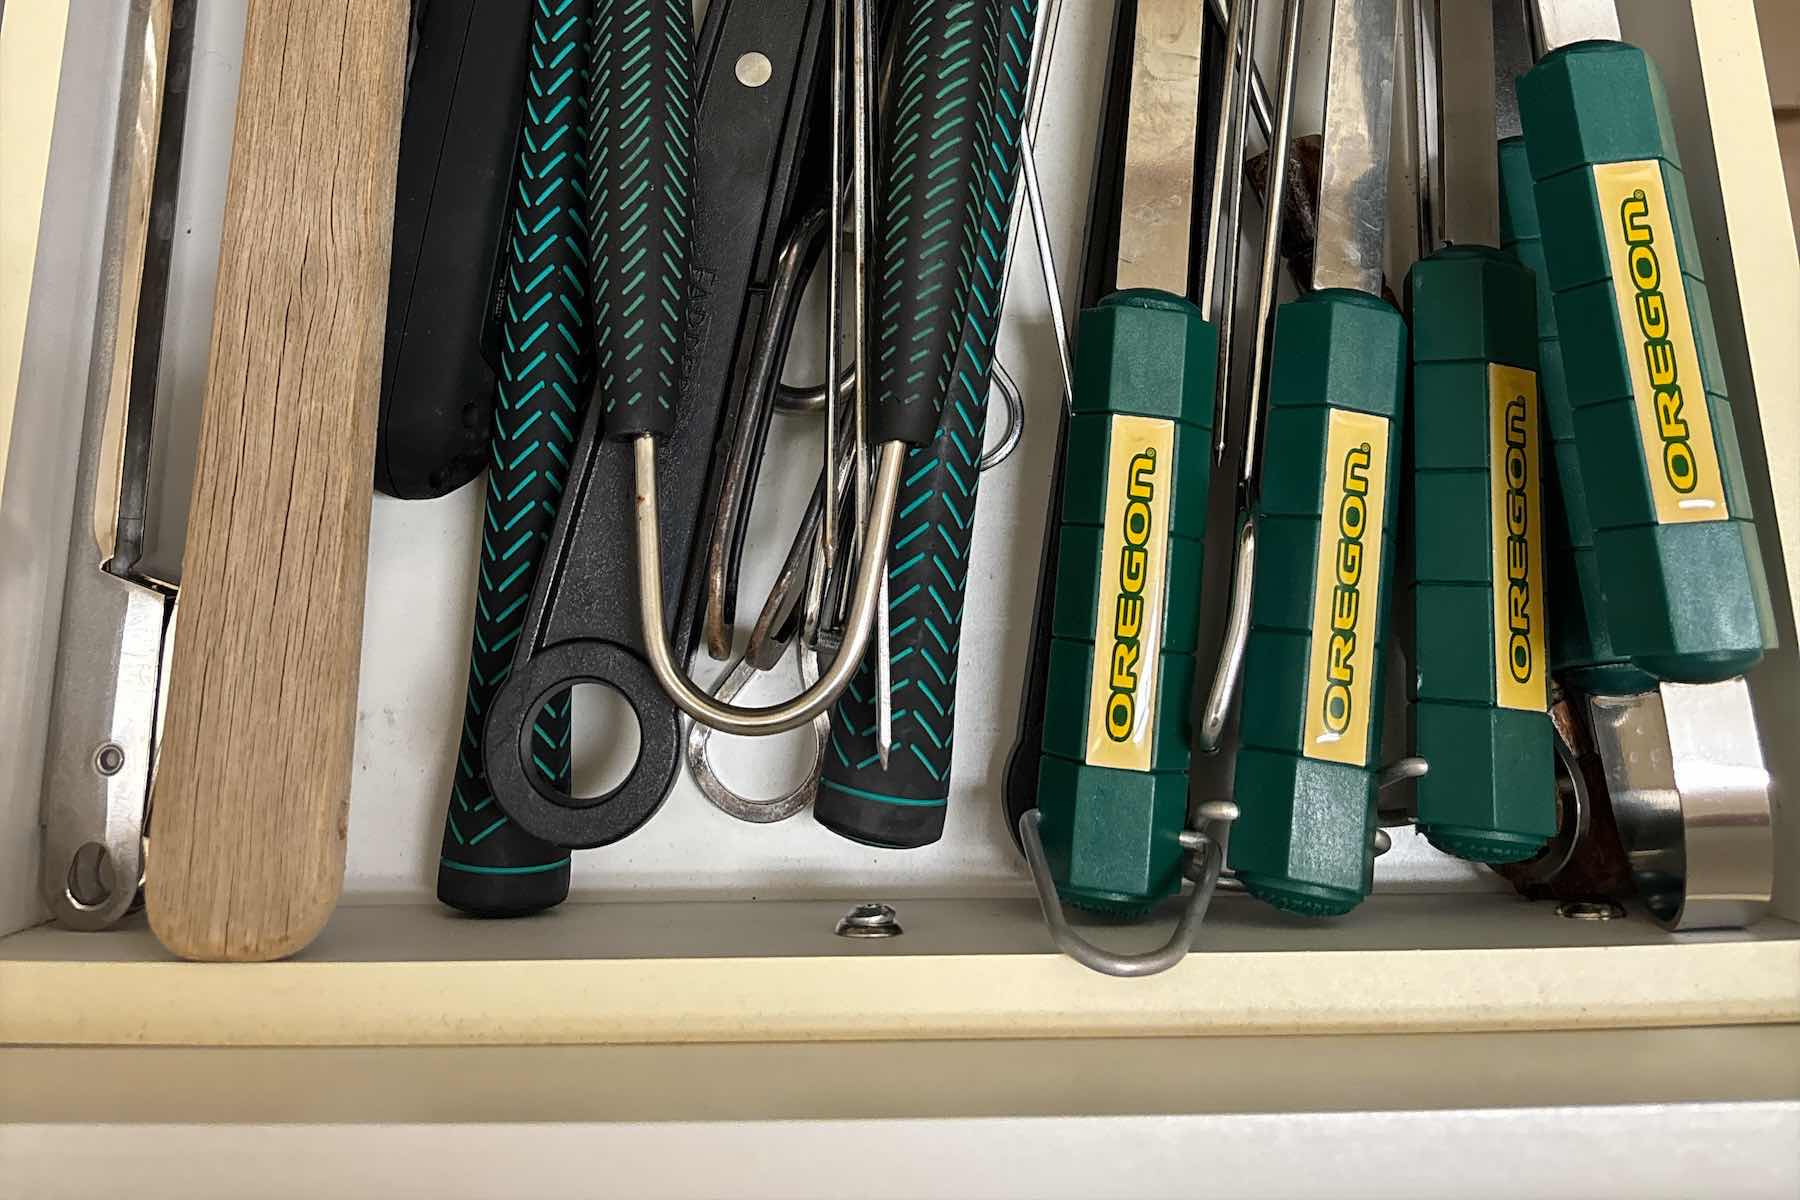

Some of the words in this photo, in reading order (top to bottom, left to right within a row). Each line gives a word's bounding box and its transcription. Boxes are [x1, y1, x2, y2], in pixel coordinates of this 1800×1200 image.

[1620, 194, 1698, 494] OREGON
[1105, 450, 1156, 742] OREGON
[1322, 446, 1370, 736] OREGON
[1505, 399, 1531, 684] OREGON
